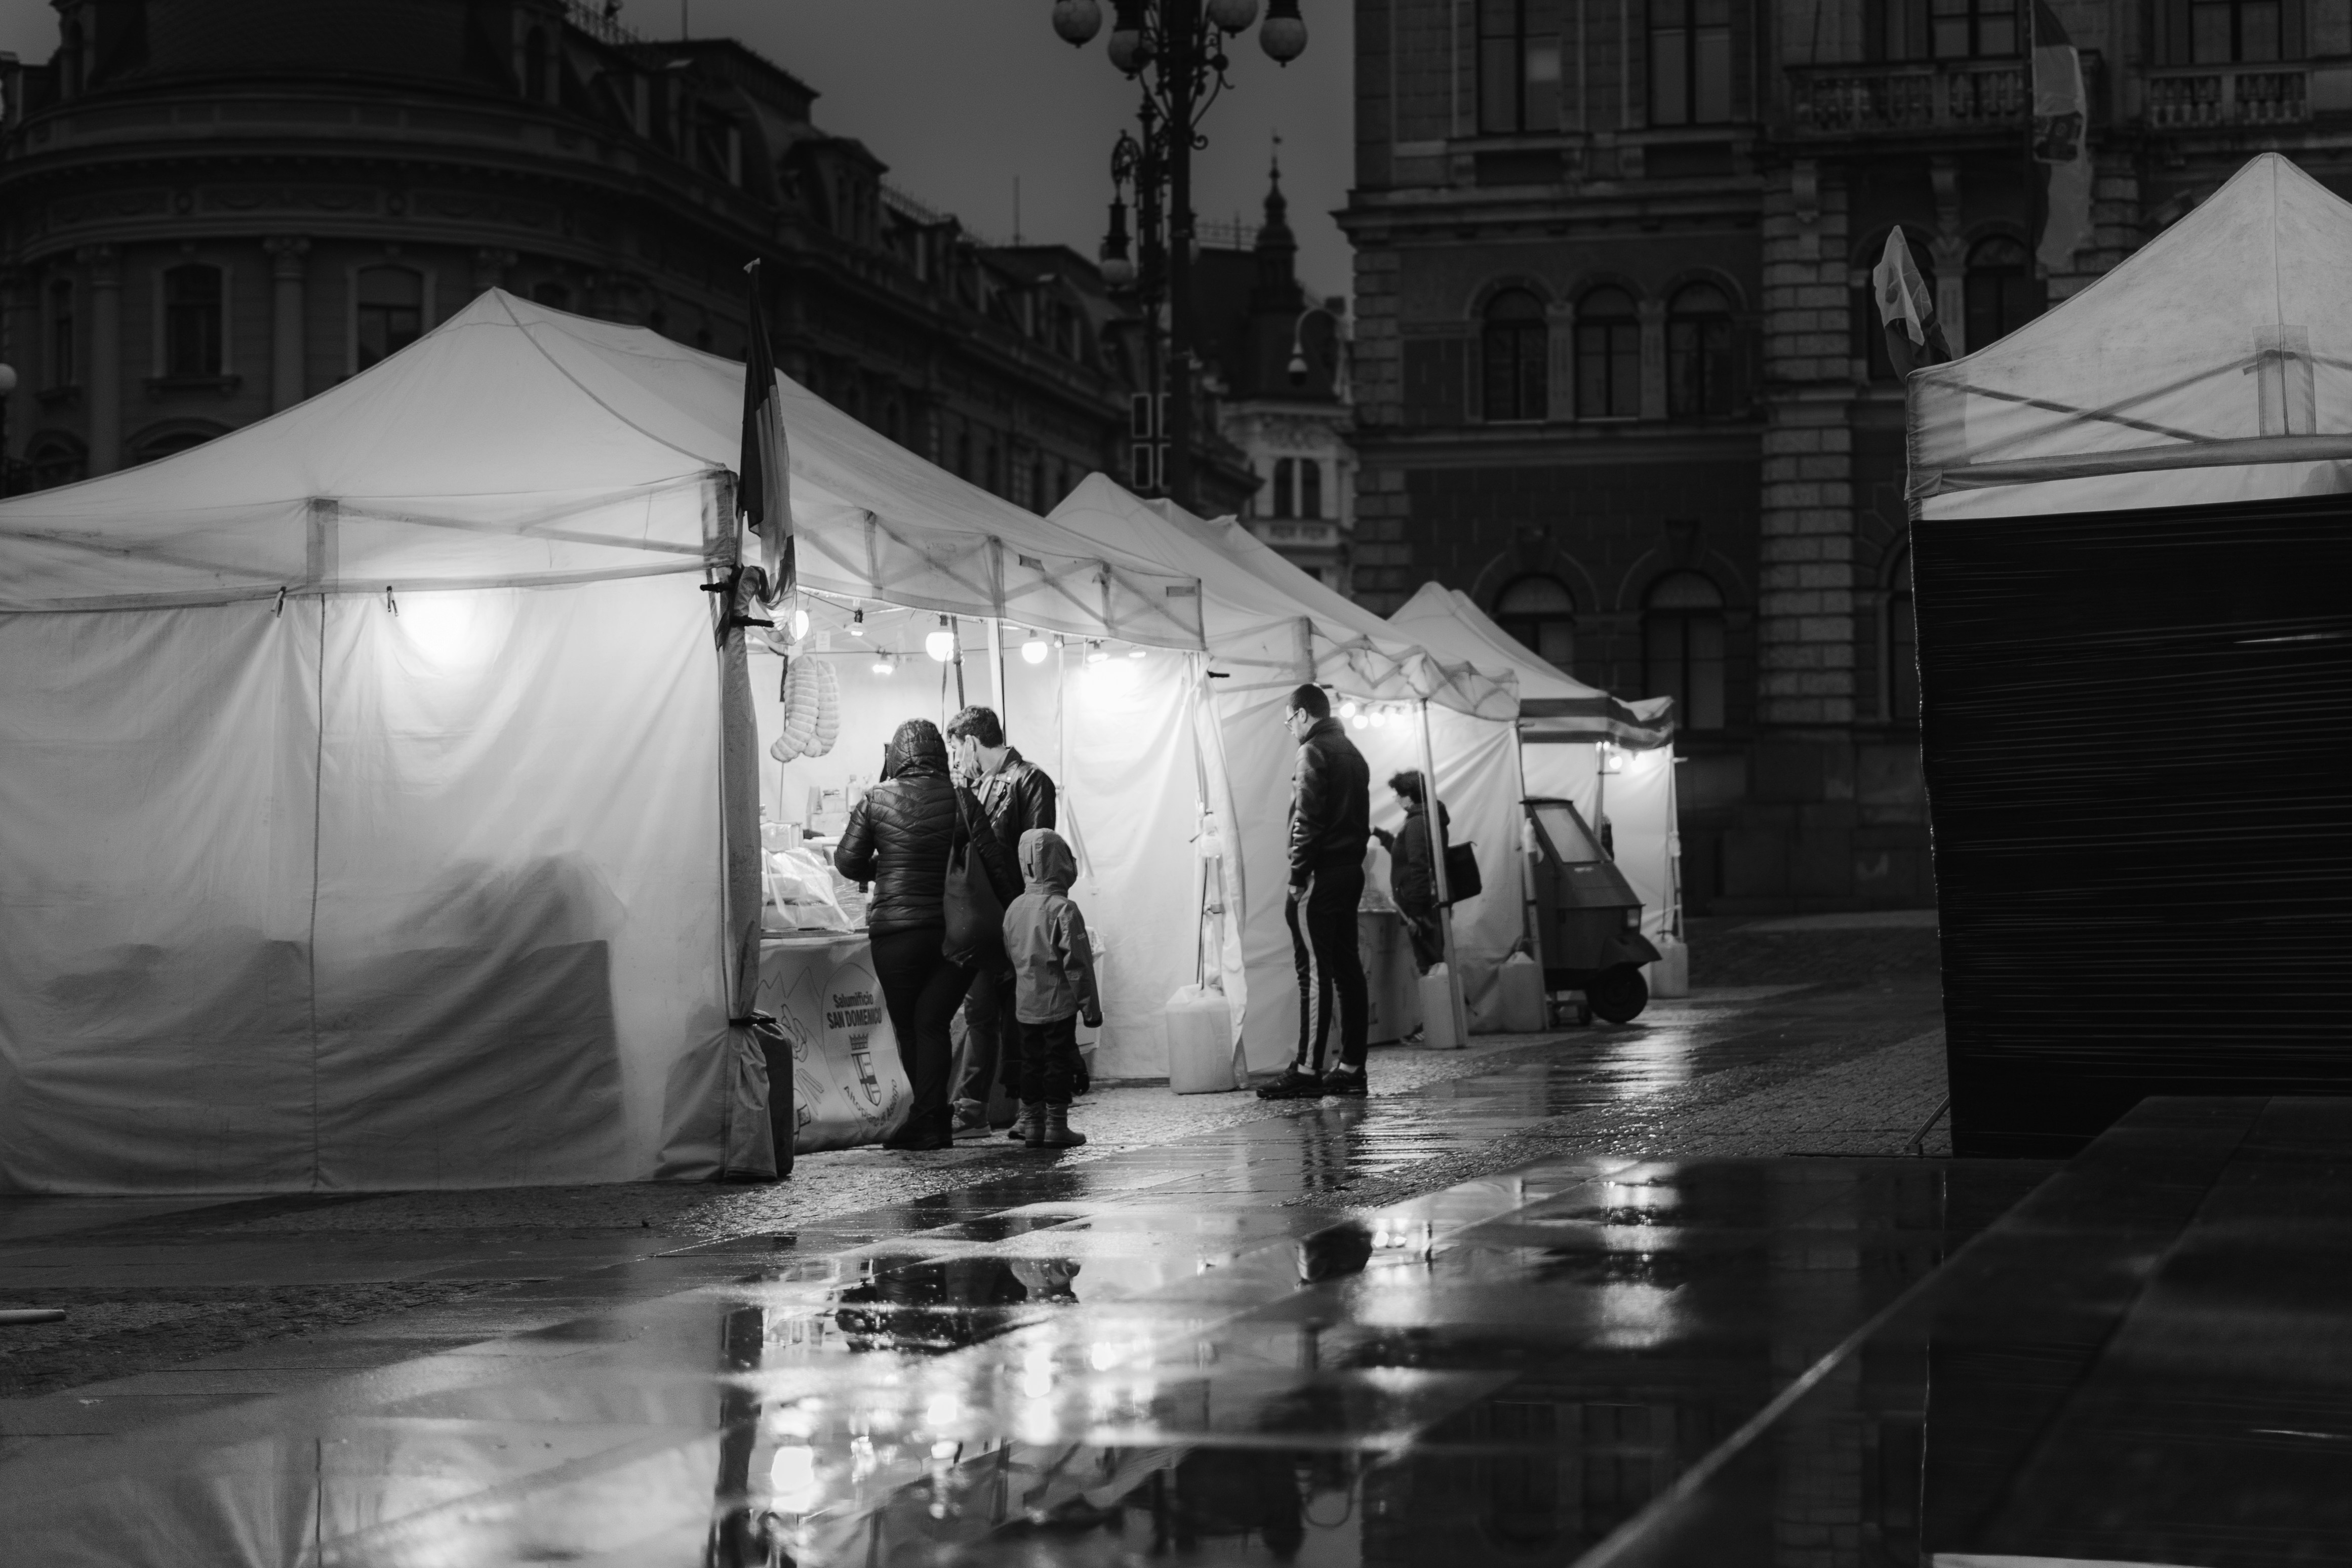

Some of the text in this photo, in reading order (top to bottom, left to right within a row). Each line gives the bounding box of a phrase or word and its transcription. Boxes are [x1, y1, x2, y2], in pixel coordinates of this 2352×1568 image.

[833, 991, 874, 1008] Salumificio
[827, 1007, 882, 1029] SAN DOMENICO
[844, 1086, 880, 1127] Altopiano
[886, 1079, 899, 1121] Asiago
